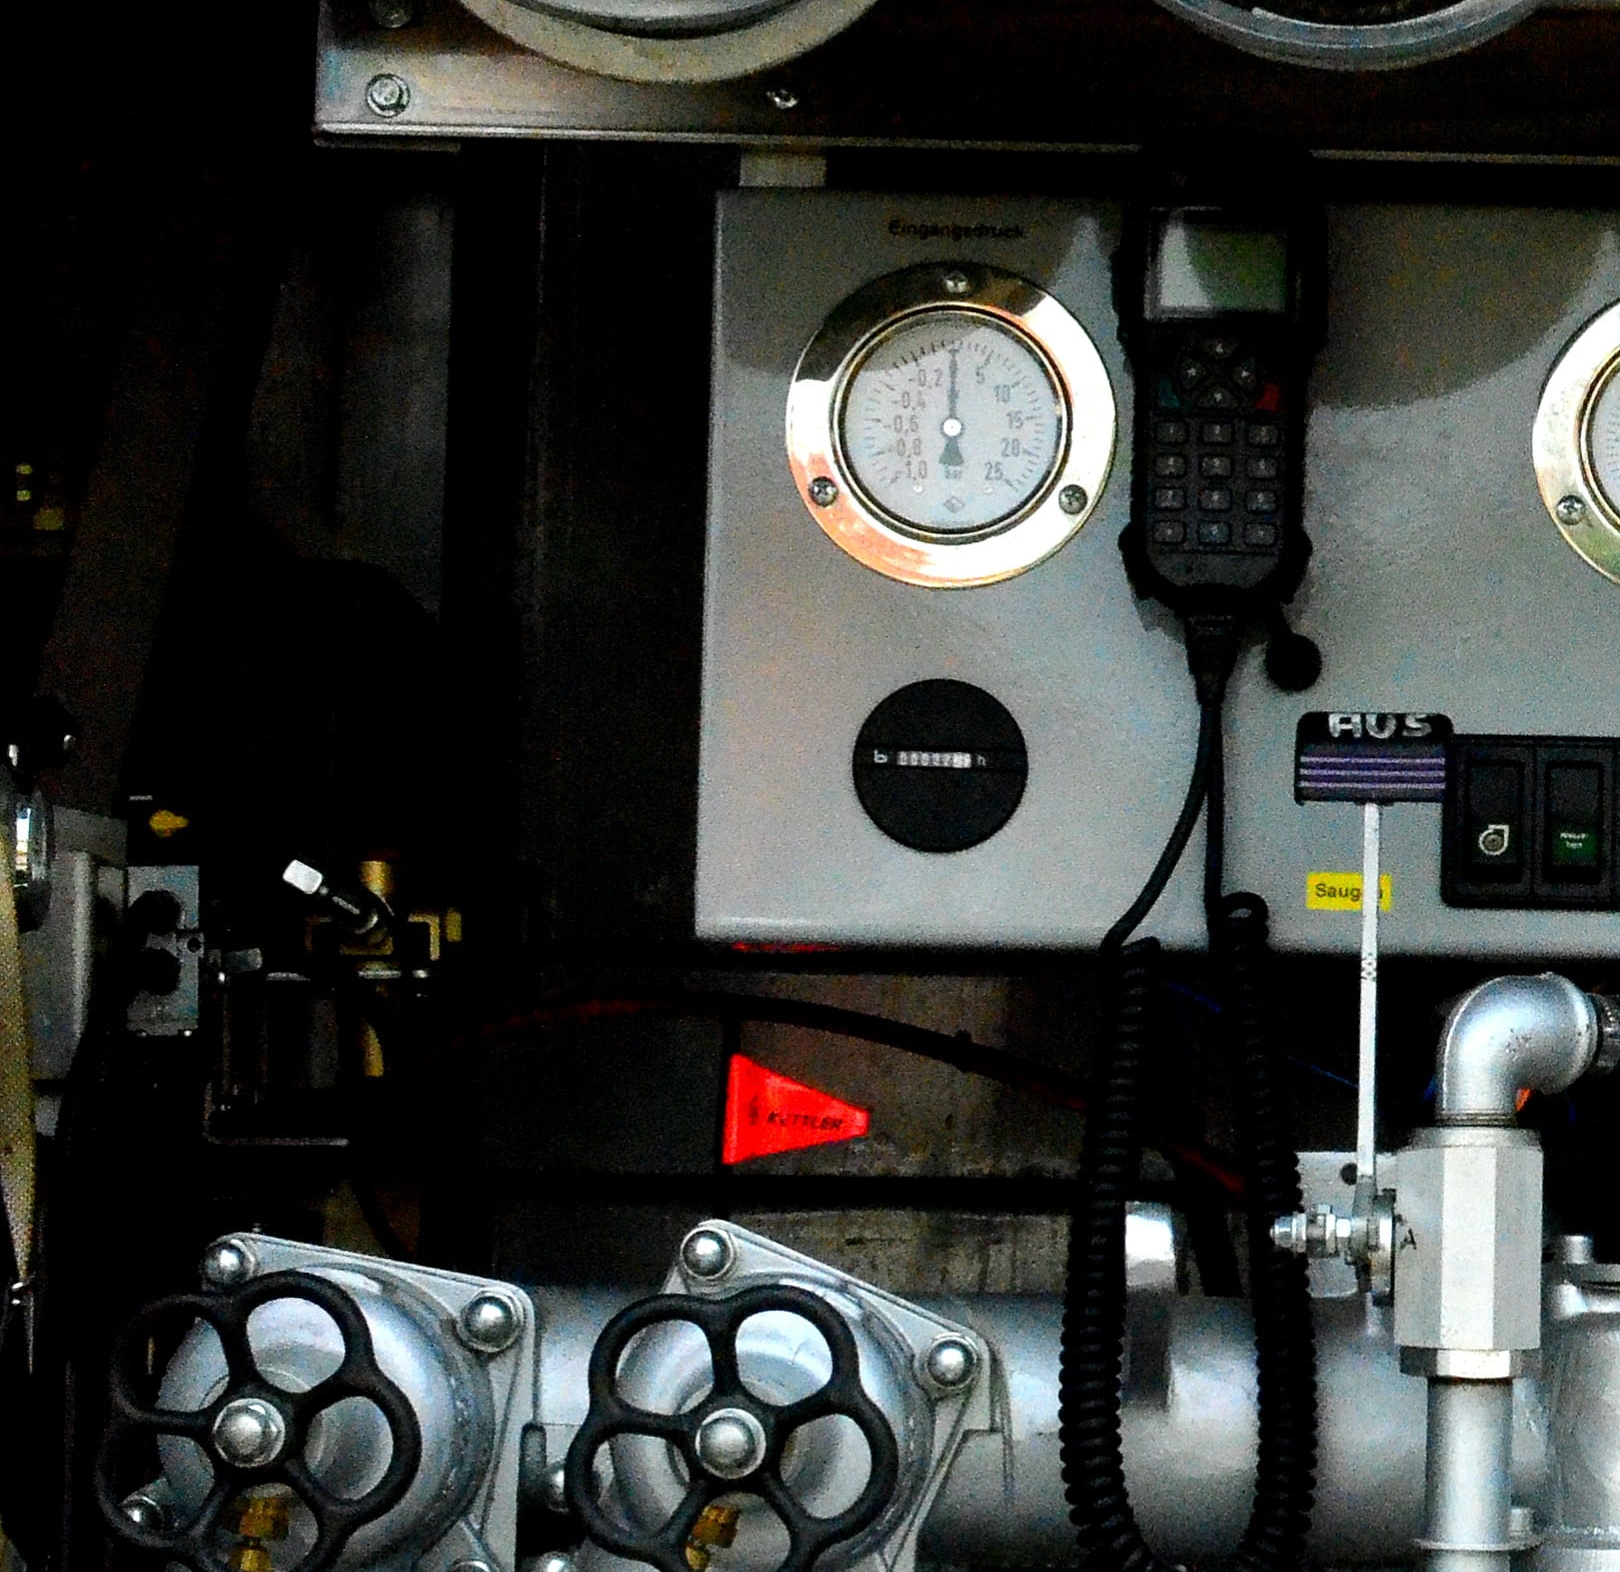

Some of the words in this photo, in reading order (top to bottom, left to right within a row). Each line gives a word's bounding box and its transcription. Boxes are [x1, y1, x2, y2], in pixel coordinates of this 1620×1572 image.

[993, 385, 1011, 404] 10
[1006, 410, 1024, 430] 15
[1001, 438, 1021, 458] 20
[984, 461, 1004, 481] 25
[1315, 883, 1383, 902] Saug
